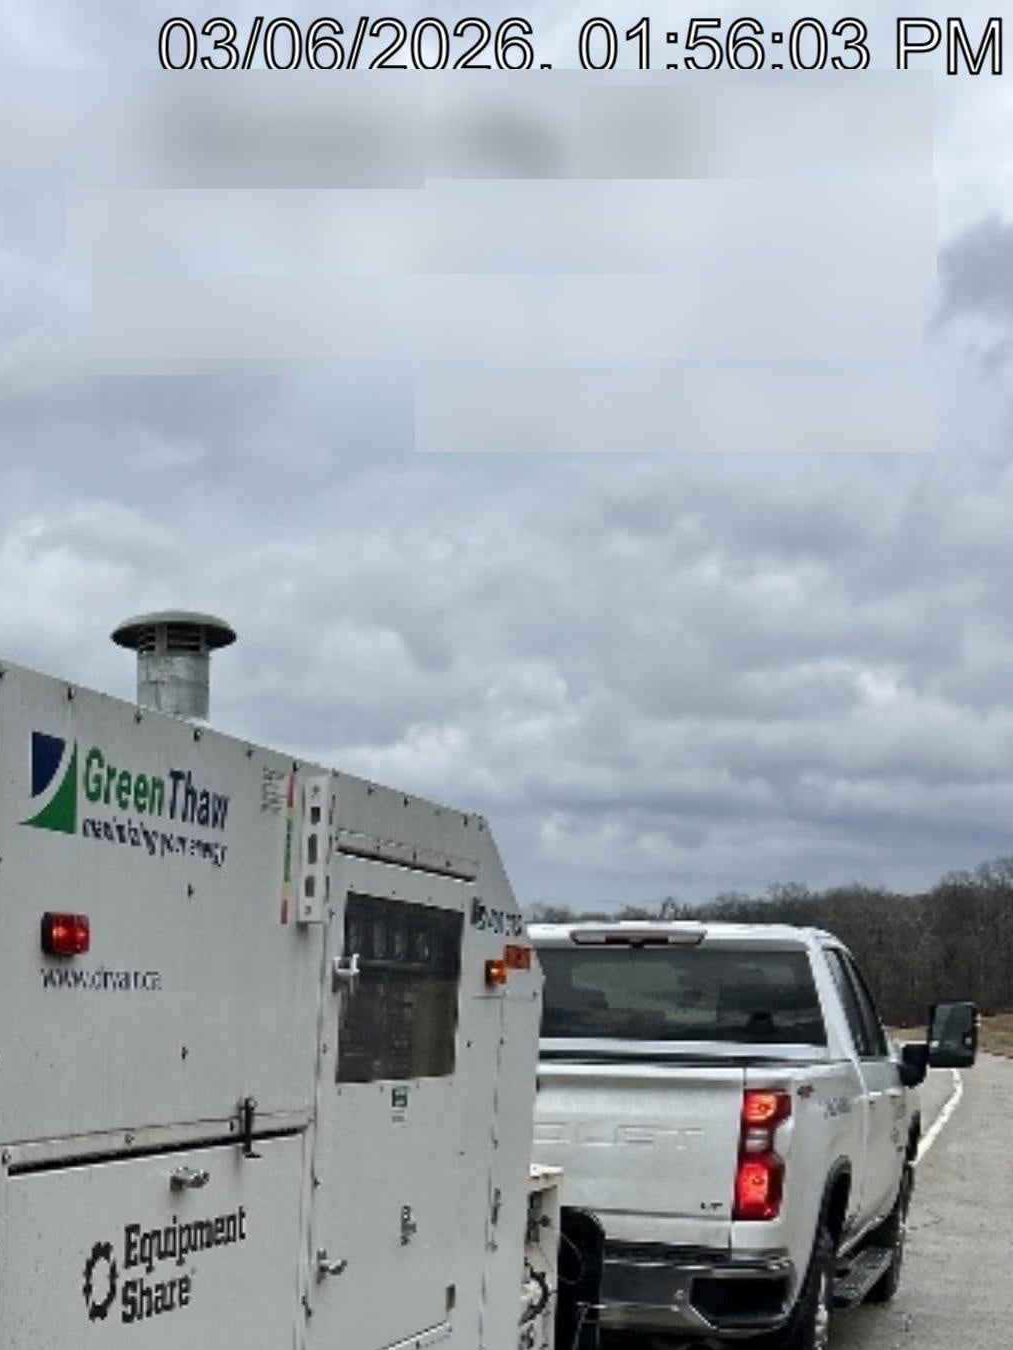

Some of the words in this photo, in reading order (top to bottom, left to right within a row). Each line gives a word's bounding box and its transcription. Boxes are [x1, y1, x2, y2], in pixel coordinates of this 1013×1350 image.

[83, 746, 230, 832] GreenThaw
[123, 1205, 247, 1275] Equipment
[121, 1275, 192, 1324] Share
